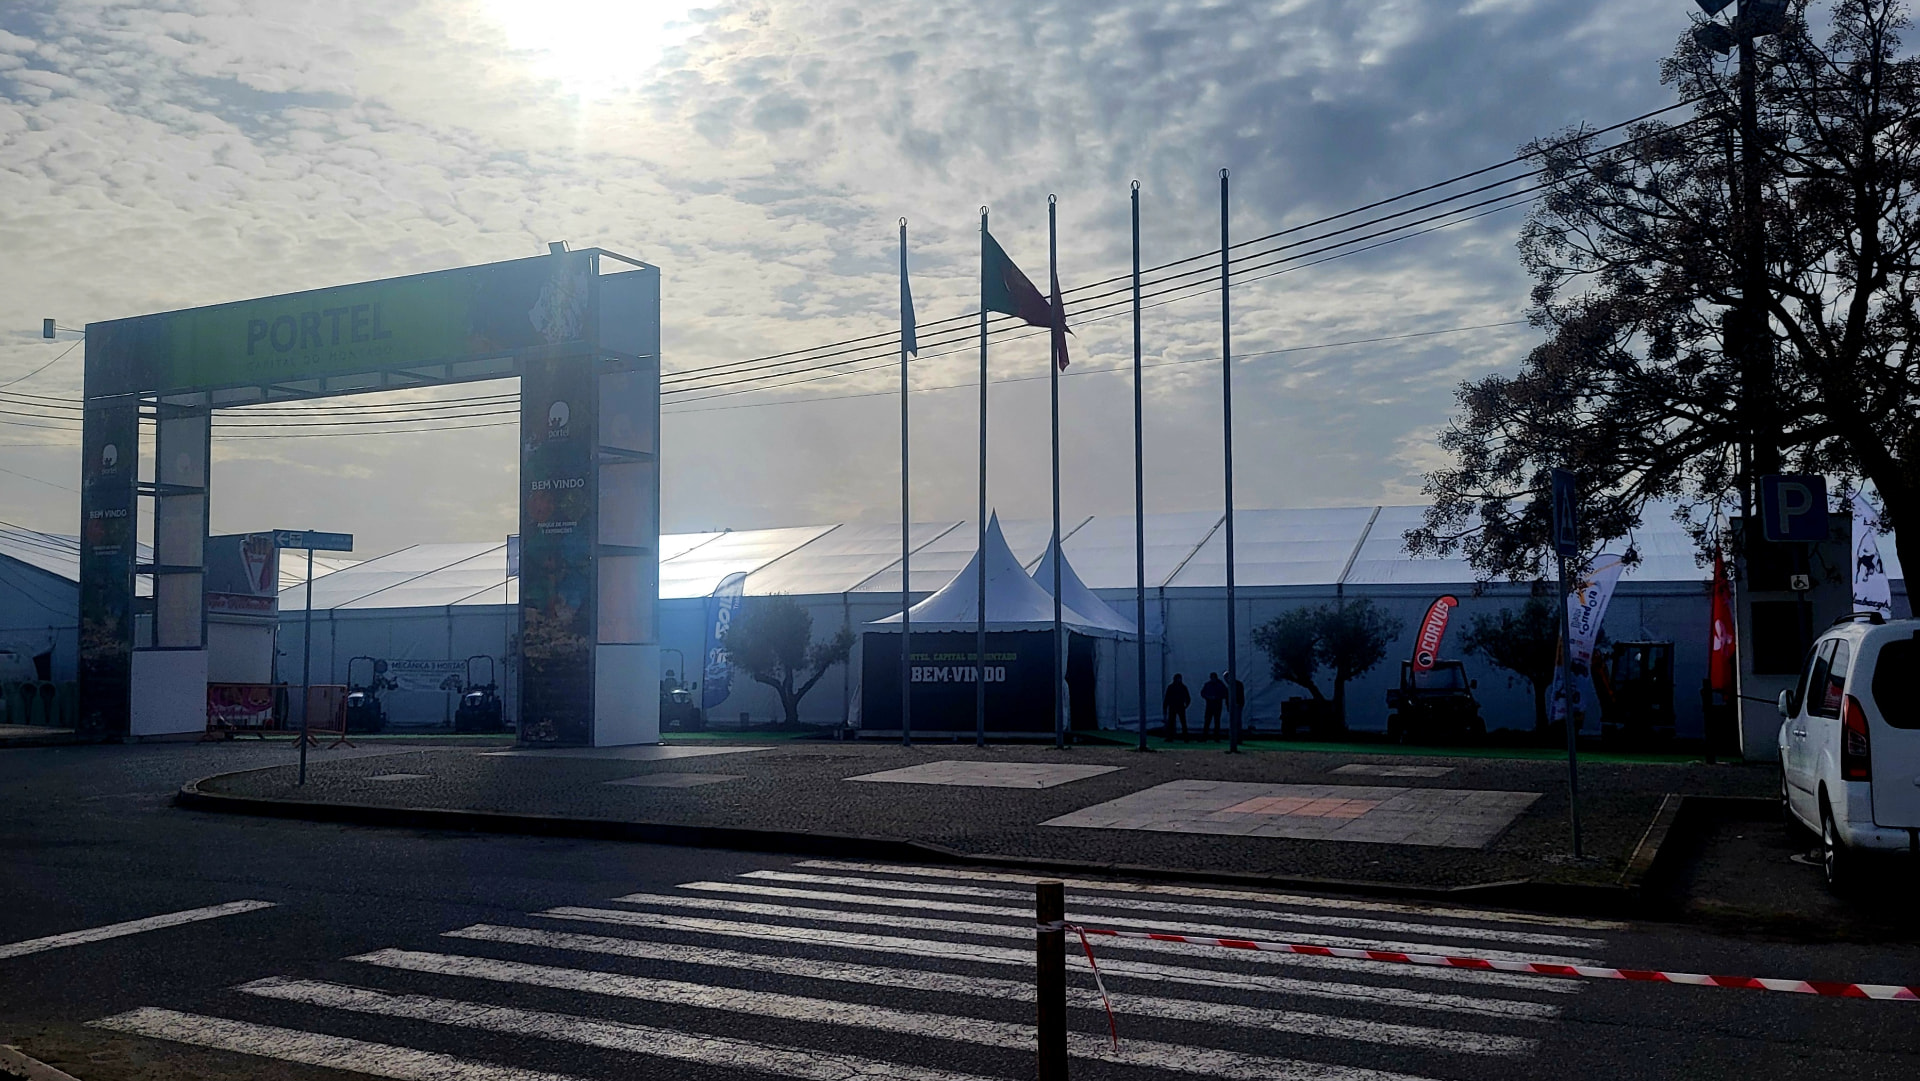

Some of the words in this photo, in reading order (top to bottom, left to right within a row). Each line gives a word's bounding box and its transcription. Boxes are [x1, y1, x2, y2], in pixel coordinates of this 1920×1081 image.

[247, 301, 392, 356] PORTEL
[531, 480, 551, 491] BEM
[552, 478, 584, 490] VINDO
[90, 510, 103, 519] BEM
[104, 508, 127, 518] VINDO
[1777, 482, 1812, 534] P
[1421, 599, 1449, 652] CORVUS
[933, 652, 967, 661] CAPITAL
[910, 666, 1006, 683] BEM-VINDO
